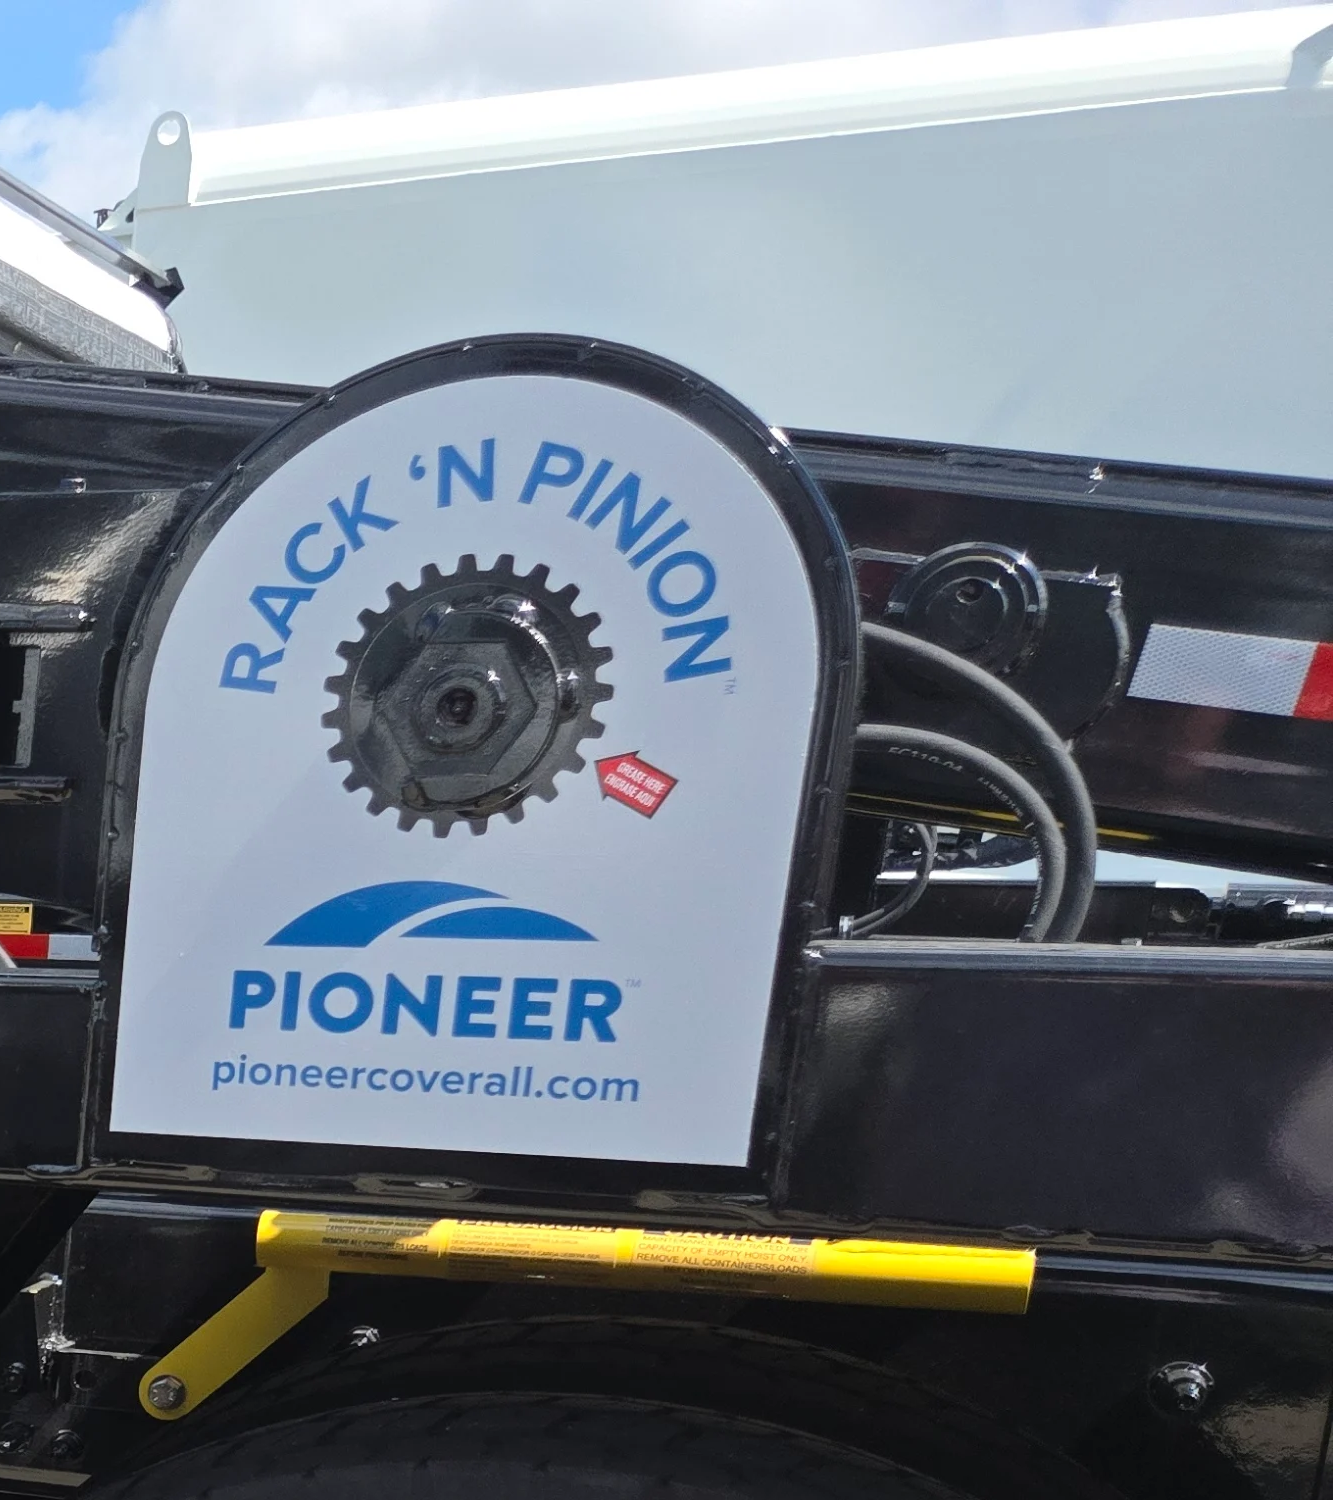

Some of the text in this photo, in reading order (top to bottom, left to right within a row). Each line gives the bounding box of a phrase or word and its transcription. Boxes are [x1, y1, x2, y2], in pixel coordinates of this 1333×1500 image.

[219, 474, 398, 694] RACK
[520, 440, 735, 684] PINION
[604, 773, 656, 807] ENGRASE AQUI
[616, 762, 666, 794] GREASE HERE
[229, 970, 623, 1043] PIONEER
[211, 1053, 640, 1103] pioneercoverall.com
[636, 1253, 679, 1264] REMOVE
[681, 1257, 700, 1266] ALL
[638, 1243, 810, 1264] CAPACITY OF EMPTY HOIST ONLY.
